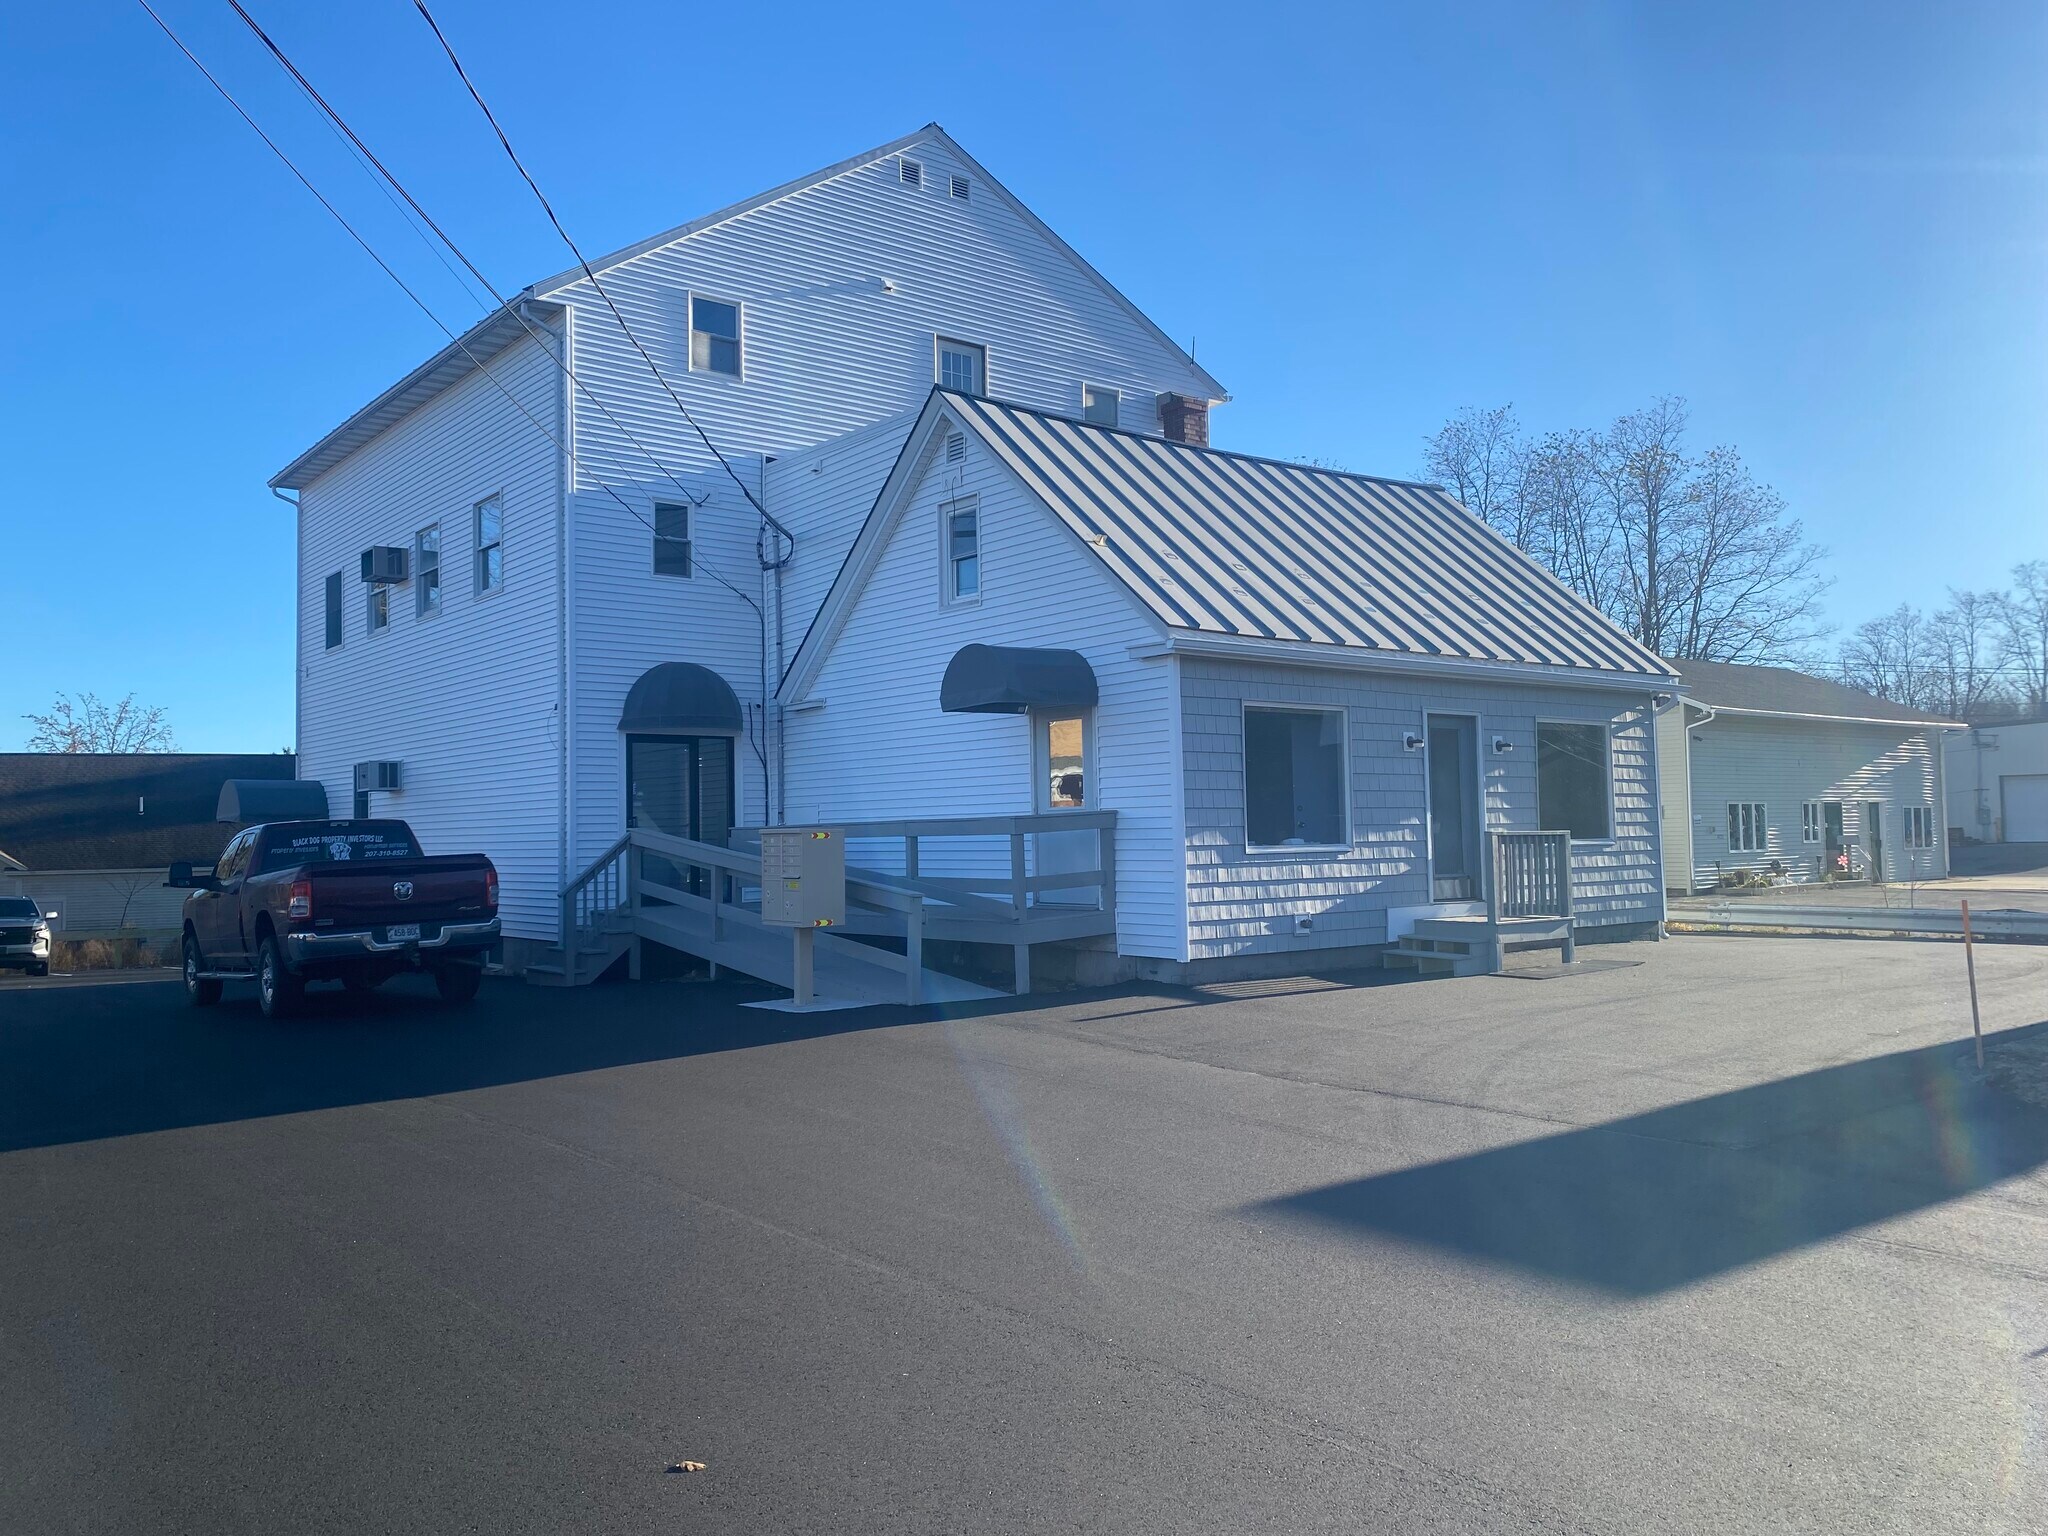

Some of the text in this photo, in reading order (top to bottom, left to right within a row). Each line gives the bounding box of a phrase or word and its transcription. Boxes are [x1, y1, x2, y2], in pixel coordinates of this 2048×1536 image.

[292, 837, 309, 847] BLACK
[309, 836, 320, 844] DOG
[321, 835, 347, 844] PROPERTY
[347, 834, 375, 843] INVESTORS
